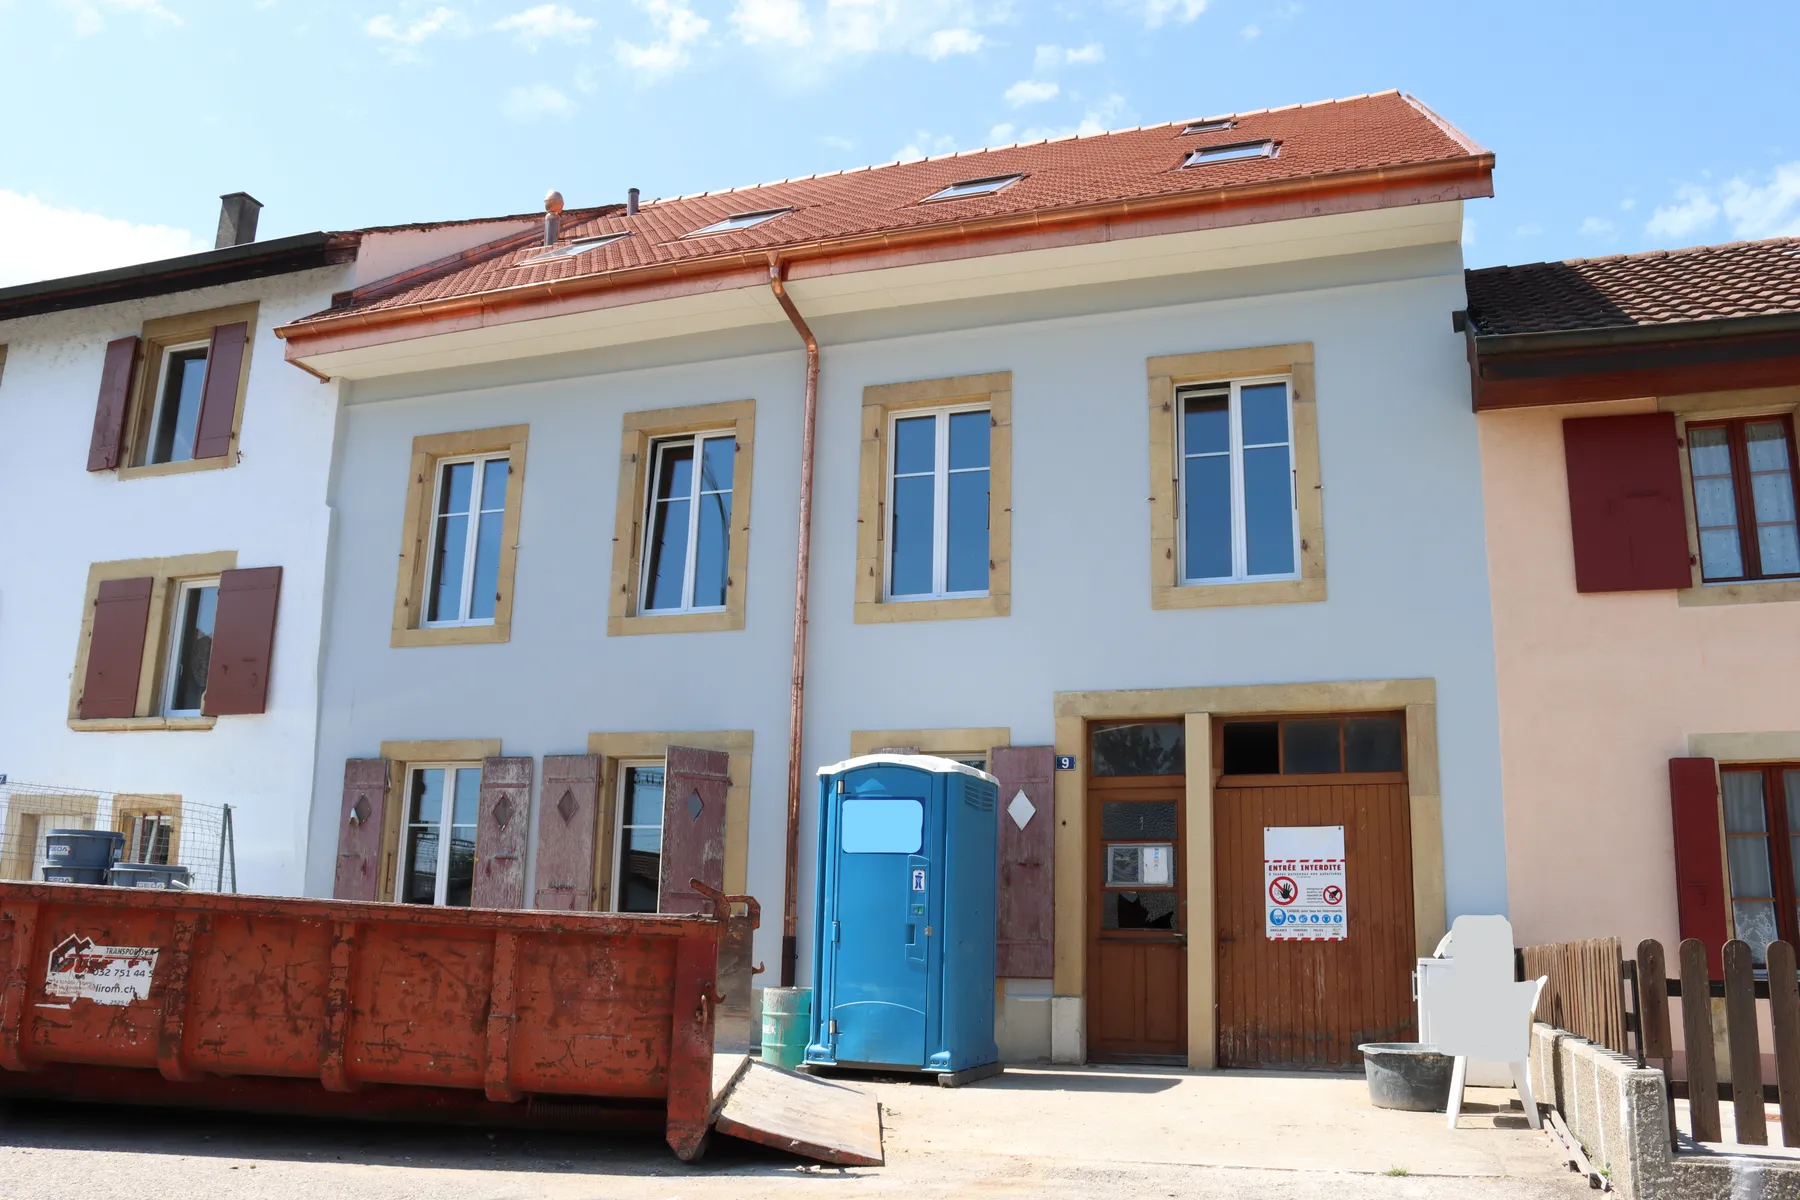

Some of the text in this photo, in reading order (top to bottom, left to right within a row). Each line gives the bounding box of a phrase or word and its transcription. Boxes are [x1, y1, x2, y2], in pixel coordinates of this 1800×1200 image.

[1061, 757, 1069, 769] 9
[1269, 863, 1296, 871] ENTRÉE
[93, 968, 110, 977] 032
[114, 968, 131, 978] 751
[133, 969, 146, 978] 44
